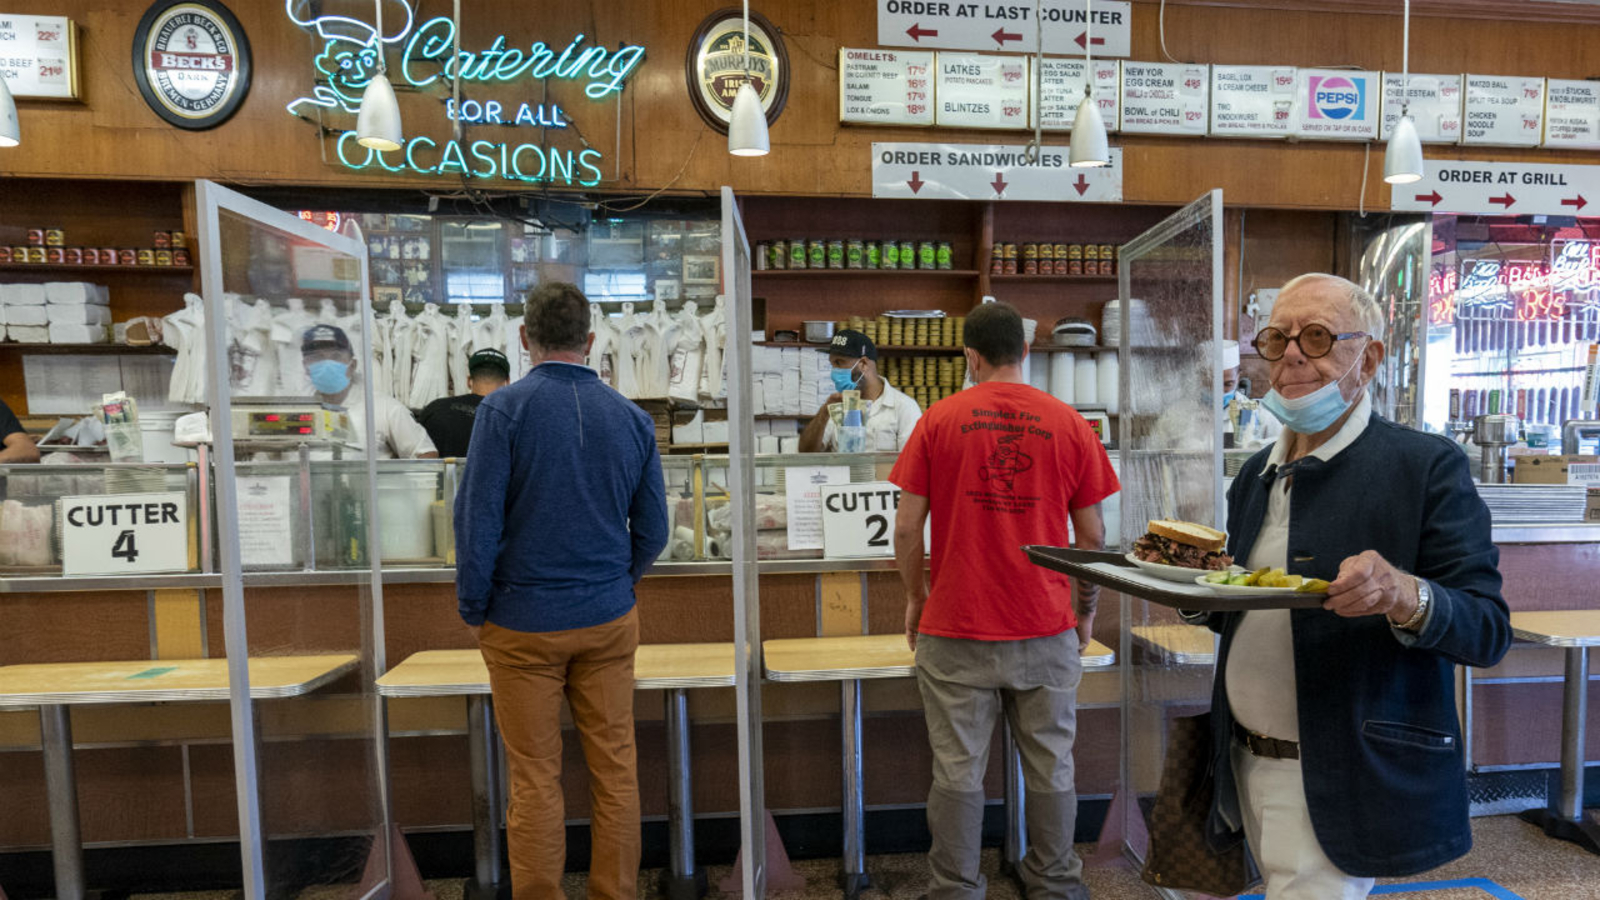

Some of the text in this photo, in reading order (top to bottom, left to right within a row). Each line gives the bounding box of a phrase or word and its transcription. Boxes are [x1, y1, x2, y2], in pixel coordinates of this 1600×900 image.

[886, 0, 1122, 25] ORDER AT LAST COUNTER
[9, 58, 33, 67] BEEF
[403, 17, 645, 98] Catering
[847, 52, 897, 62] OMELETS:
[944, 64, 981, 76] LATKES
[1125, 68, 1144, 76] NEW
[178, 73, 209, 81] DARK
[1125, 79, 1174, 87] EGG CREAM
[1245, 84, 1268, 92] CHEESE
[1492, 81, 1508, 89] BALL
[1317, 92, 1358, 105] PEPSI
[1386, 89, 1436, 97] CHEEESTEAK
[944, 102, 990, 114] BLINTZES
[1124, 107, 1149, 116] BOWL
[1160, 108, 1179, 117] CHILI
[515, 103, 567, 127] ALL
[1468, 121, 1494, 129] NOODLE
[337, 130, 602, 186] OCCASIONS
[881, 151, 942, 165] ORDER
[948, 152, 1062, 167] SANDWICHES
[1438, 169, 1568, 186] ORDER AT GRILL
[972, 409, 1016, 420] Simplex
[1028, 425, 1052, 440] Corp
[825, 490, 902, 512] CUTTE
[67, 502, 180, 528] CUTTER
[866, 514, 889, 547] 2
[111, 530, 139, 563] 4
